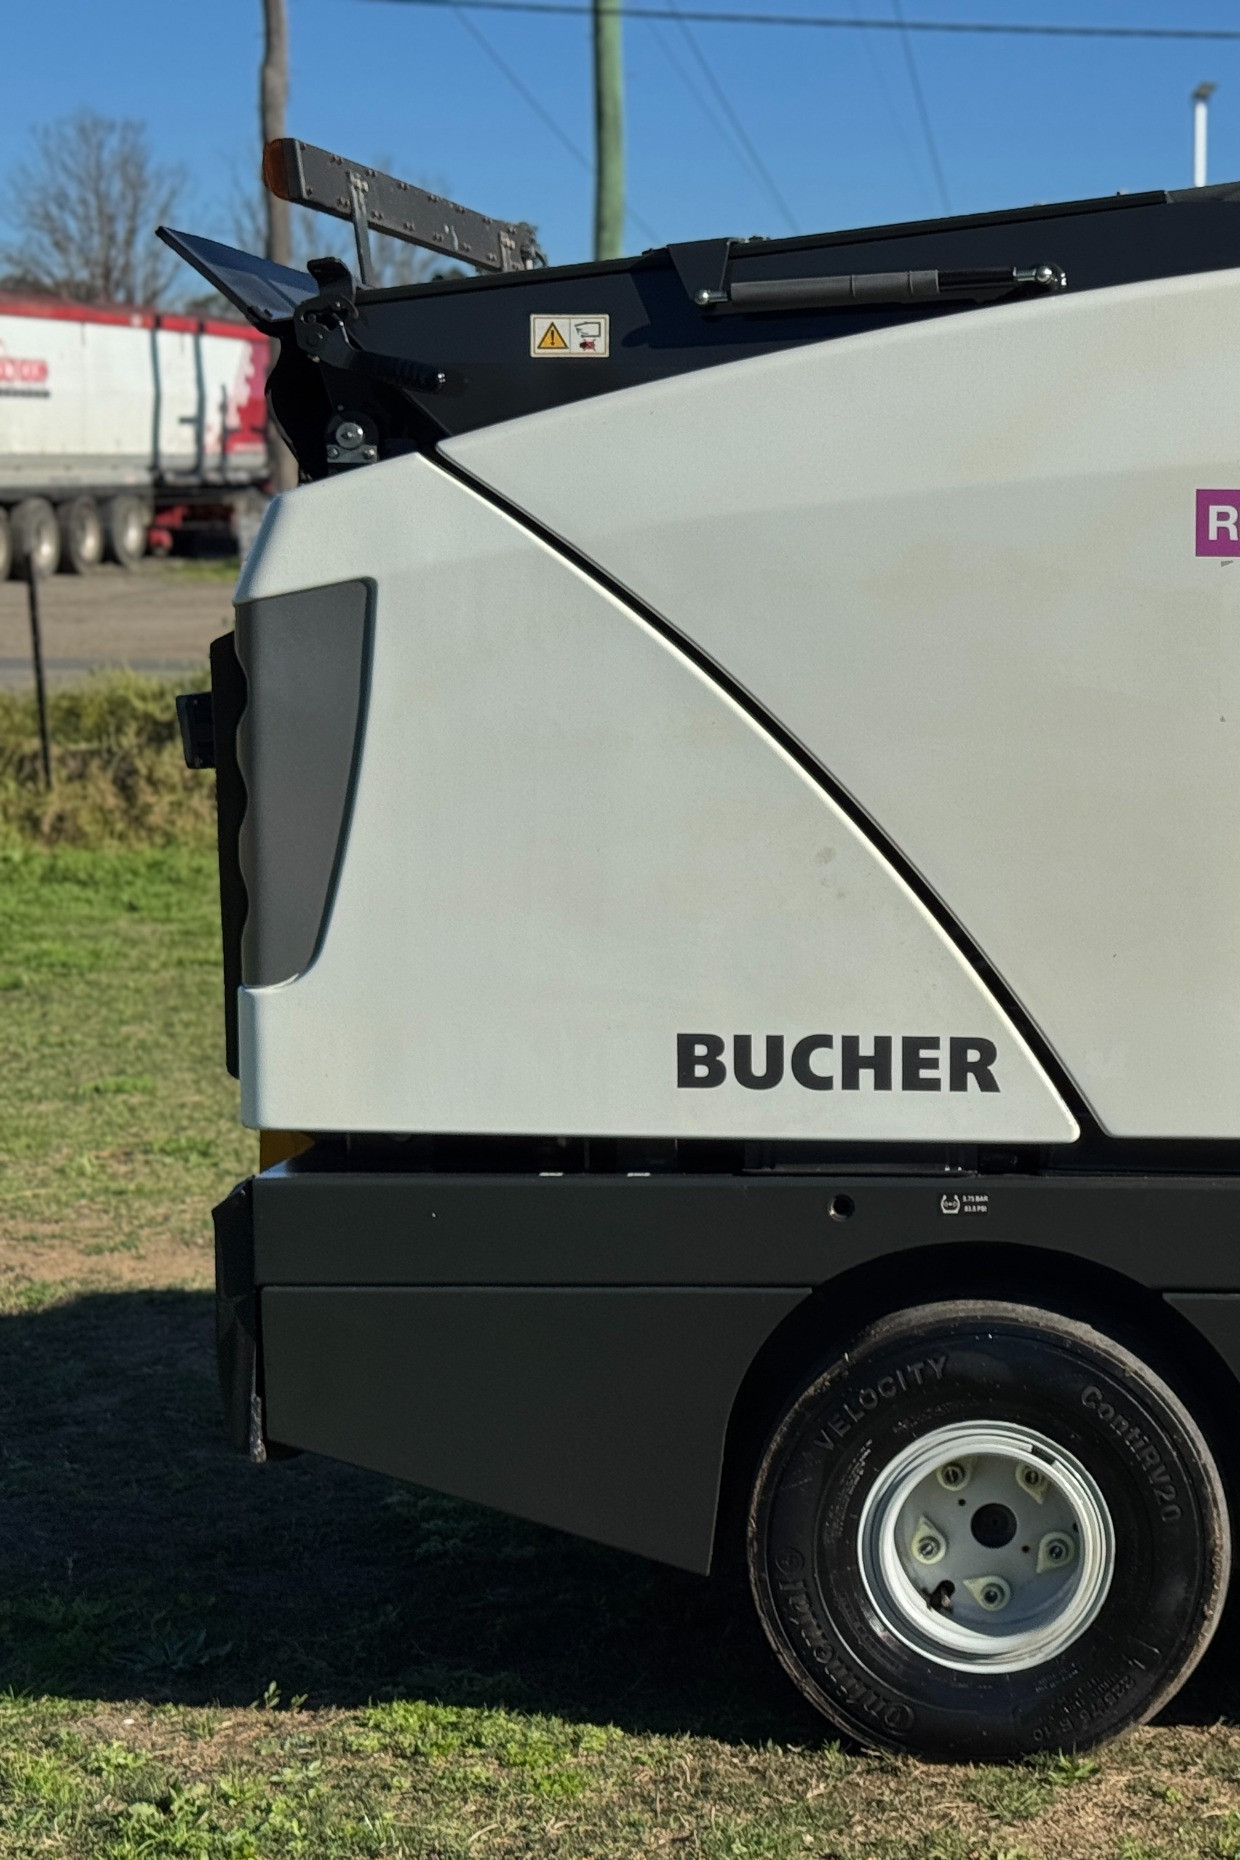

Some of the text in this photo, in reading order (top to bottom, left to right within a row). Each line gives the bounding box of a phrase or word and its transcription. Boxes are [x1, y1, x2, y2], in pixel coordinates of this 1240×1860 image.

[676, 1033, 1001, 1093] BUCHER
[813, 1355, 948, 1451] VELOCITY
[1081, 1385, 1182, 1522] ContiRV20
